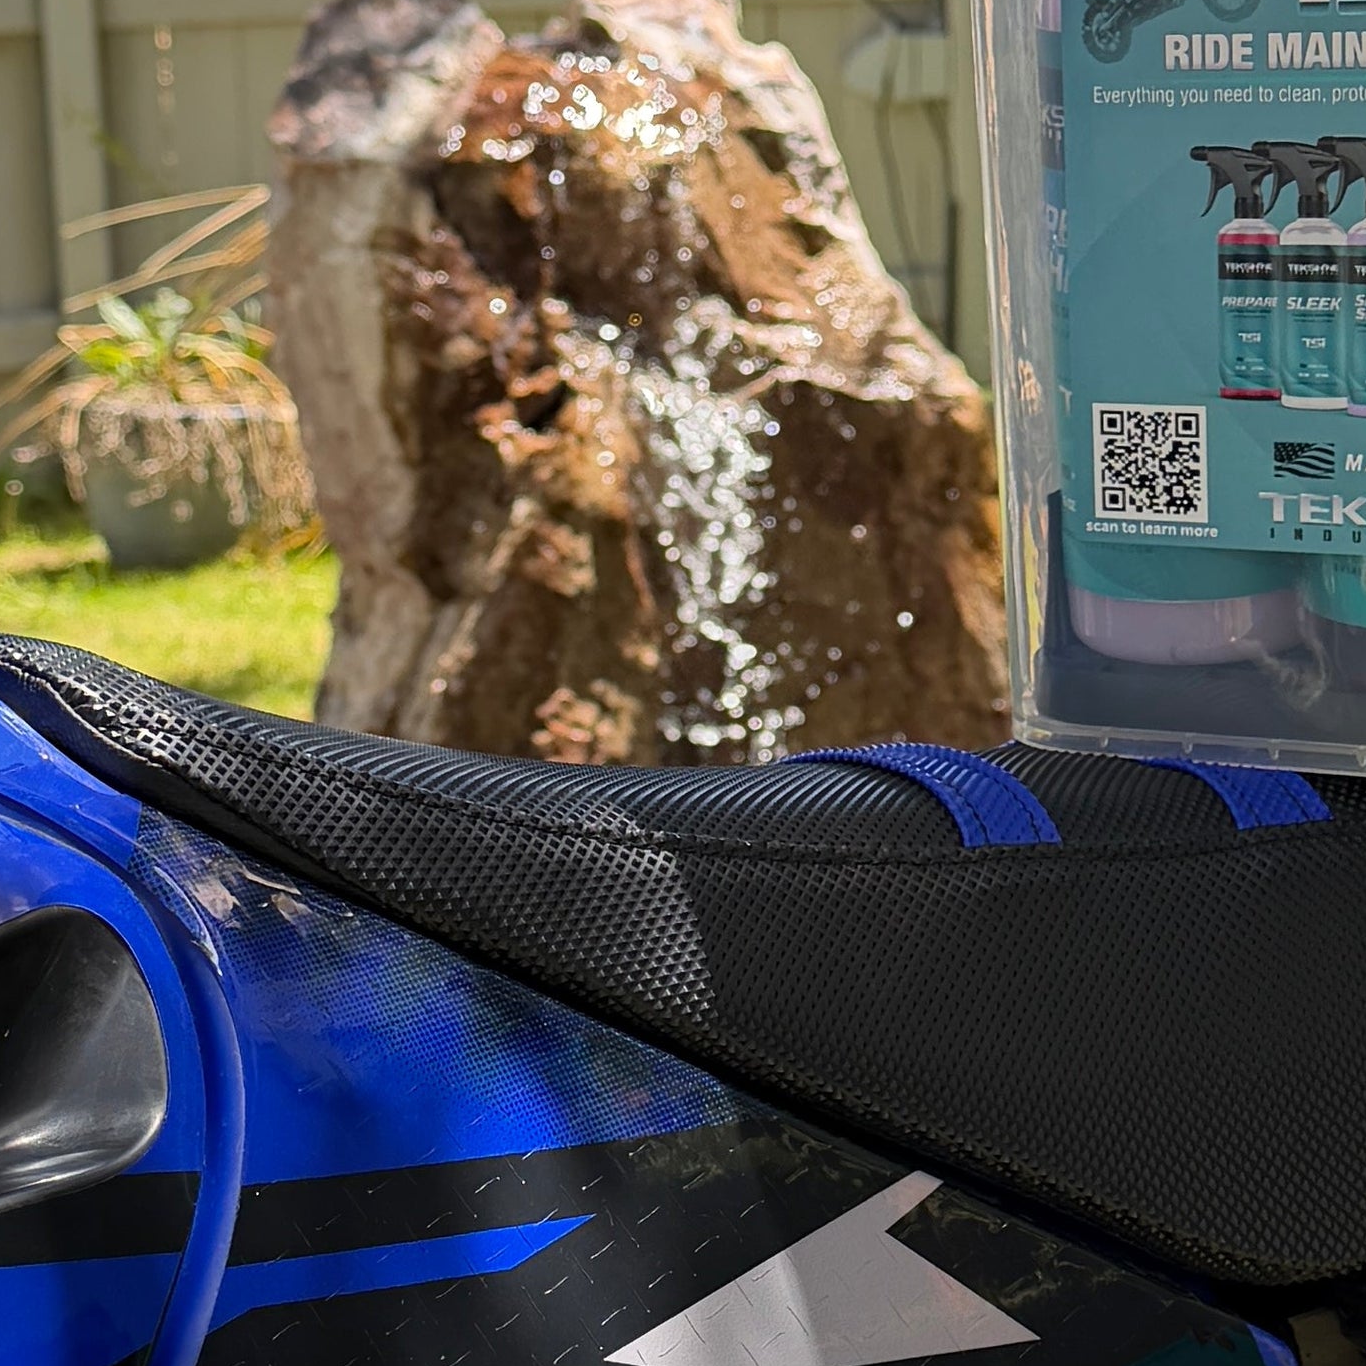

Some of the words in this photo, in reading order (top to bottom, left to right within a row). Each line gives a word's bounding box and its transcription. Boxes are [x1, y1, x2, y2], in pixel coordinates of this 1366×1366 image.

[1164, 33, 1254, 71] RIDE
[1093, 86, 1174, 107] Everything
[1180, 89, 1208, 106] you
[1214, 86, 1252, 103] need
[1258, 86, 1274, 103] to
[1278, 85, 1326, 105] clean,
[1221, 296, 1278, 307] PREPARE
[1286, 297, 1342, 311] SLEEK
[1085, 522, 1120, 534] scan
[1121, 521, 1137, 535] to
[1140, 521, 1177, 536] learn
[1180, 526, 1219, 538] more
